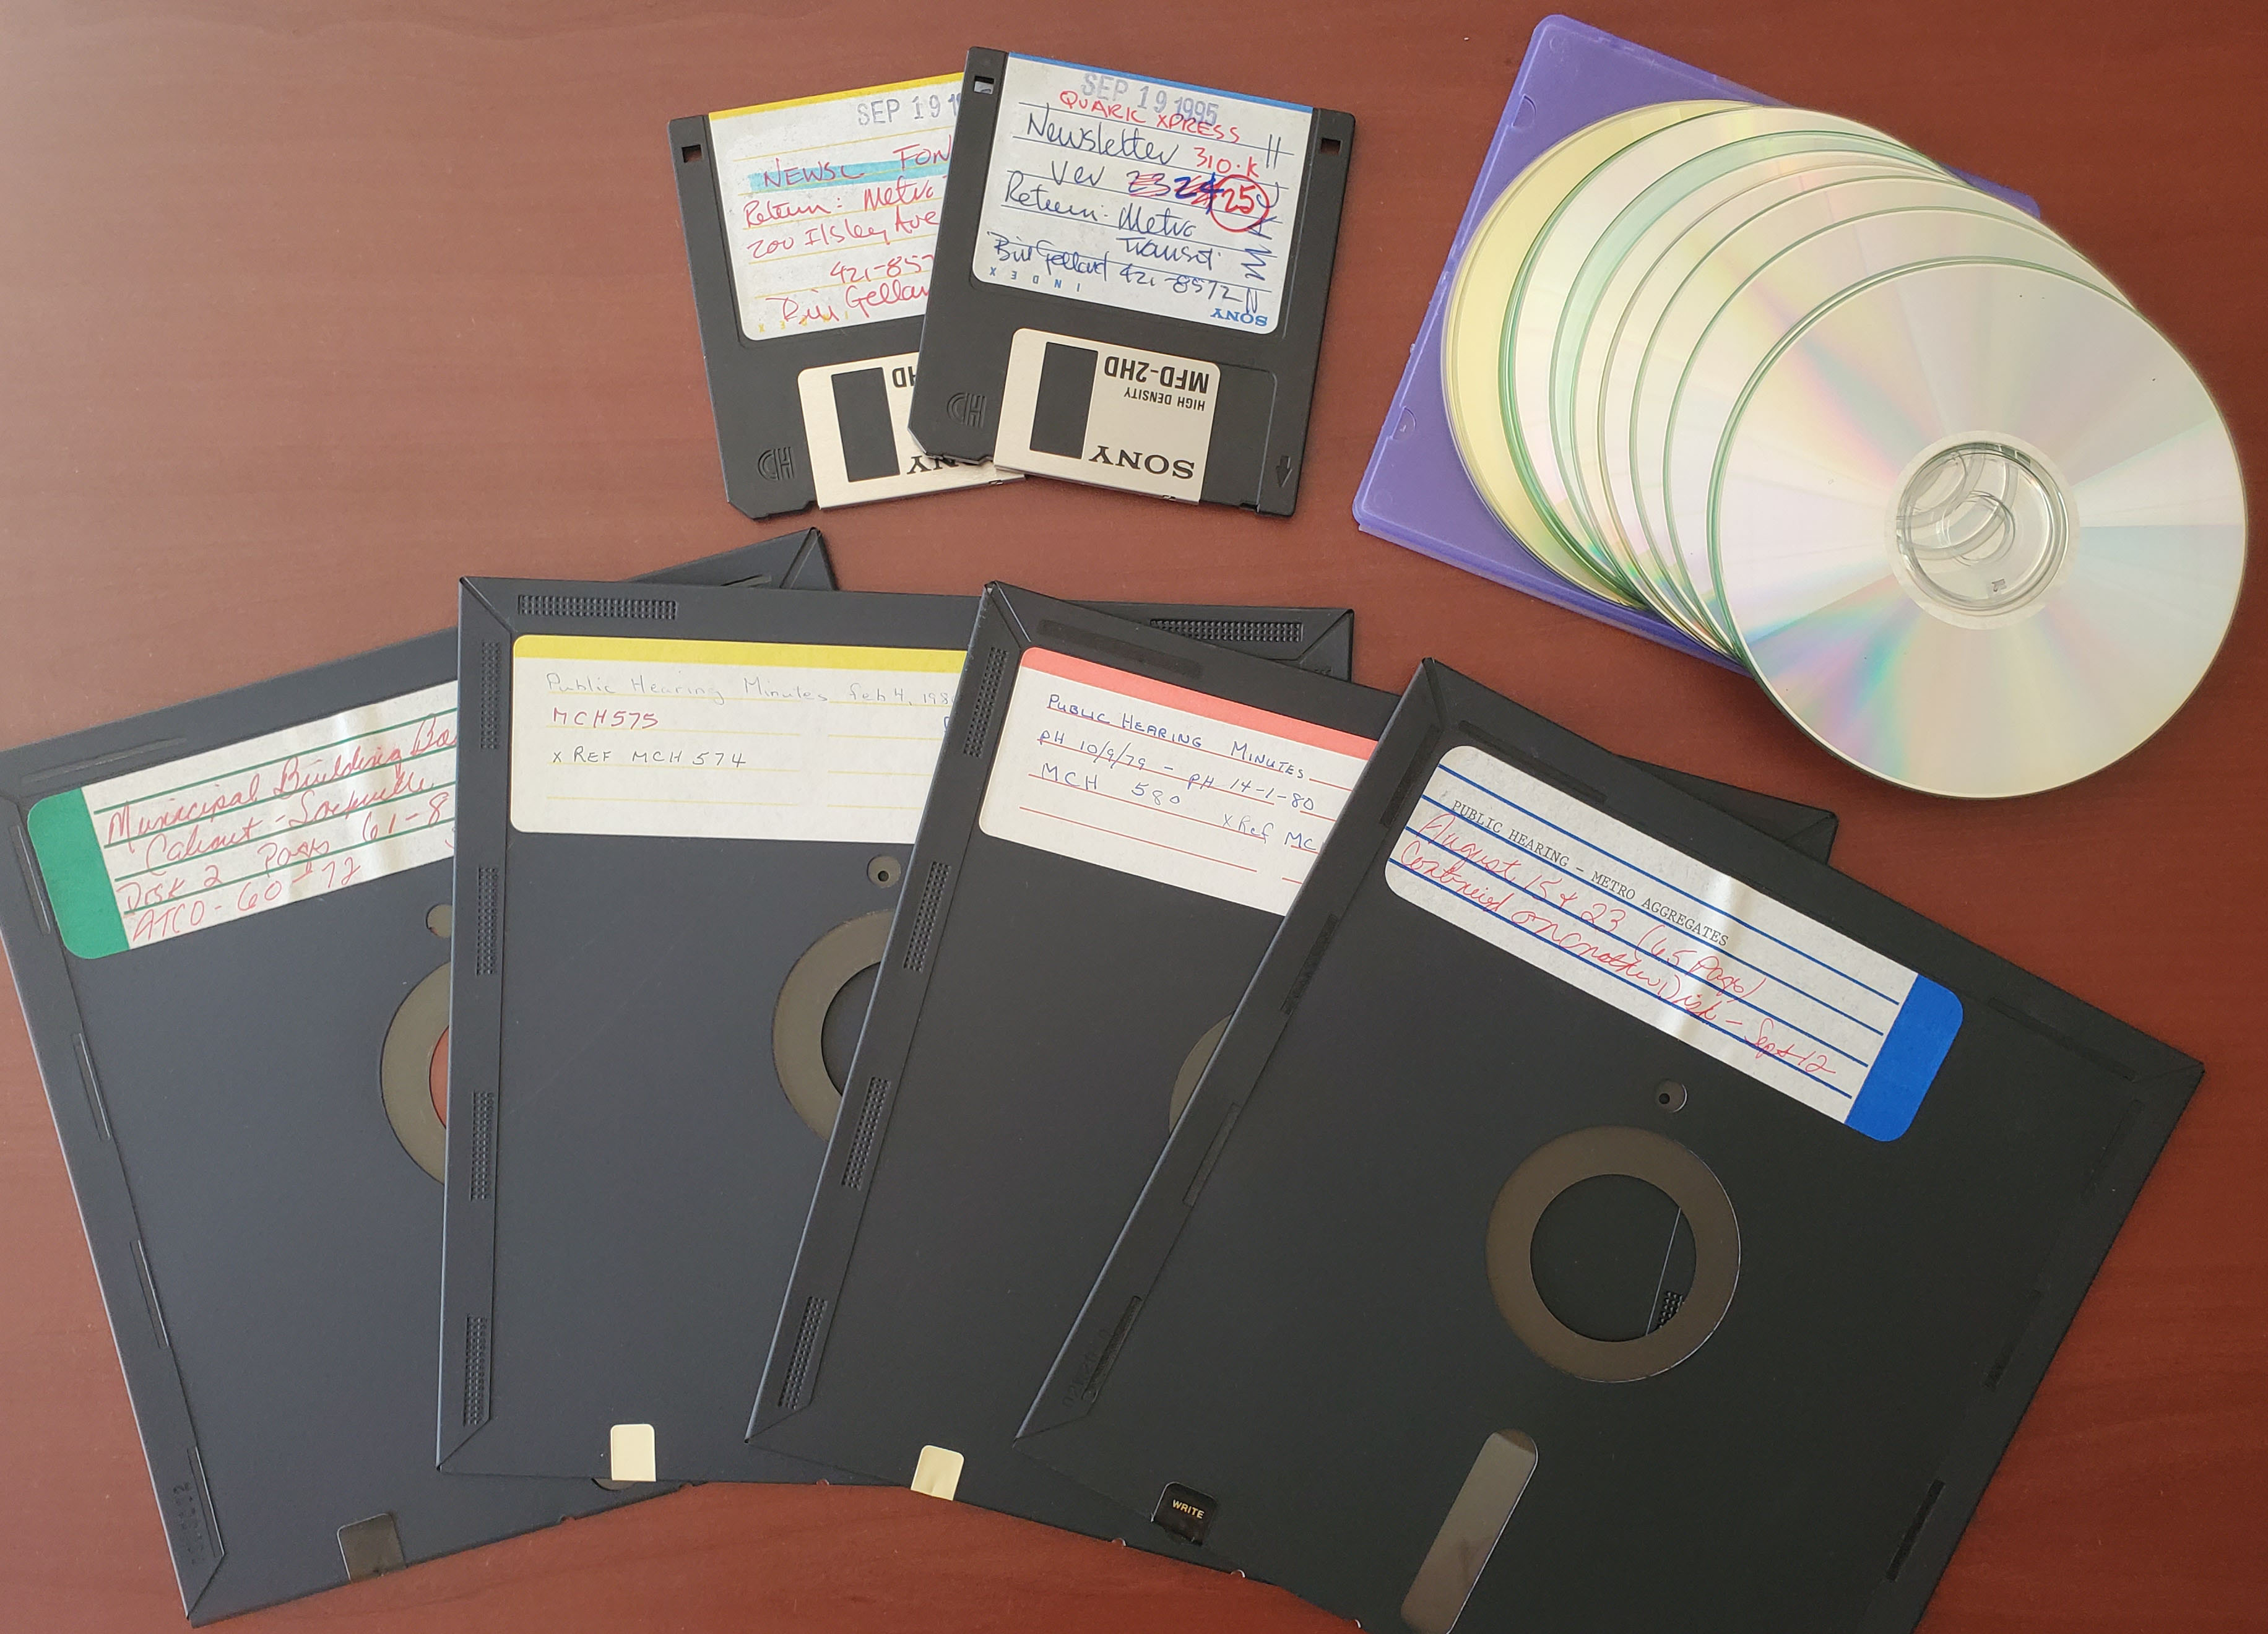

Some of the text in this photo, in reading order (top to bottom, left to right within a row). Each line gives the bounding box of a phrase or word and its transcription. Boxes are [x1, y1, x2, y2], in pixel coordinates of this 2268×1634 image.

[857, 98, 900, 126] SEP
[912, 95, 941, 121] 19
[1081, 72, 1219, 128] SEP 19 1995
[1026, 103, 1180, 165] Newsletter
[1210, 308, 1269, 327] SONY
[1103, 355, 1210, 394] MFD-2HD
[1124, 386, 1206, 412] HIGH DENSITY
[1088, 444, 1196, 480] SONY
[545, 672, 617, 695] Public
[631, 671, 725, 705] Hearing
[743, 677, 829, 702] Minutes
[924, 692, 955, 705] 198
[573, 747, 613, 765] REF
[631, 750, 683, 766] MCH
[691, 751, 747, 769] 574
[1121, 712, 1202, 749] HEARING
[1230, 740, 1305, 780] MINUTES
[1040, 763, 1182, 806] MCH 580
[203, 864, 223, 888] 2
[1451, 800, 1503, 834] PUBLIC
[1508, 828, 1570, 868] HEARING
[1590, 870, 1636, 901] METRO
[1641, 897, 1729, 946] AGGREGATES
[1172, 1498, 1206, 1520] WRITE
